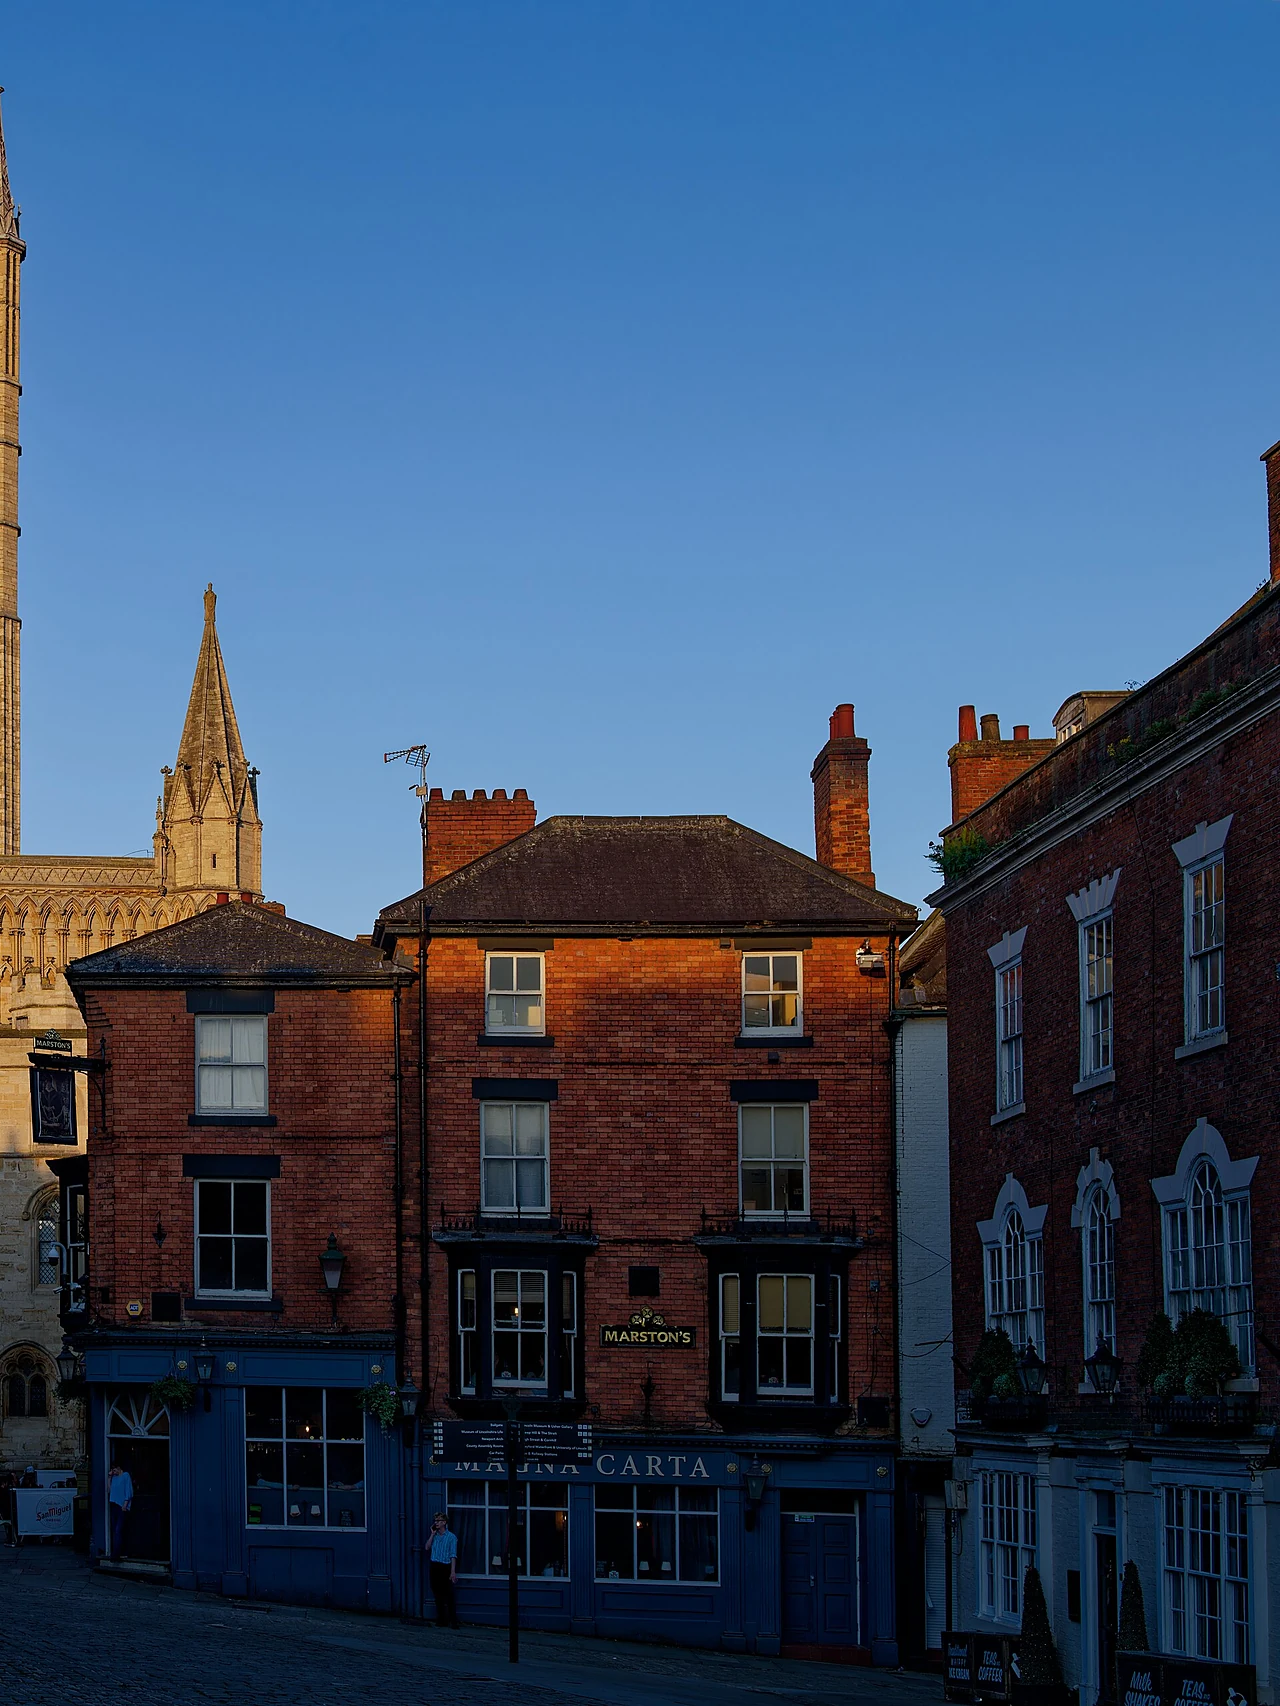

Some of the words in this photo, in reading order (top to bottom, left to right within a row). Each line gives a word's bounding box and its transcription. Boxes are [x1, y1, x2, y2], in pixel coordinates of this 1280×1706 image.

[36, 1040, 71, 1050] MARSTON'S
[604, 1330, 691, 1344] MARSTON'S
[596, 1454, 709, 1477] CARTA
[983, 1650, 998, 1666] TEAS
[978, 1666, 1003, 1683] COFFEES
[1130, 1671, 1153, 1692] Milk
[1181, 1679, 1205, 1699] TEAS
